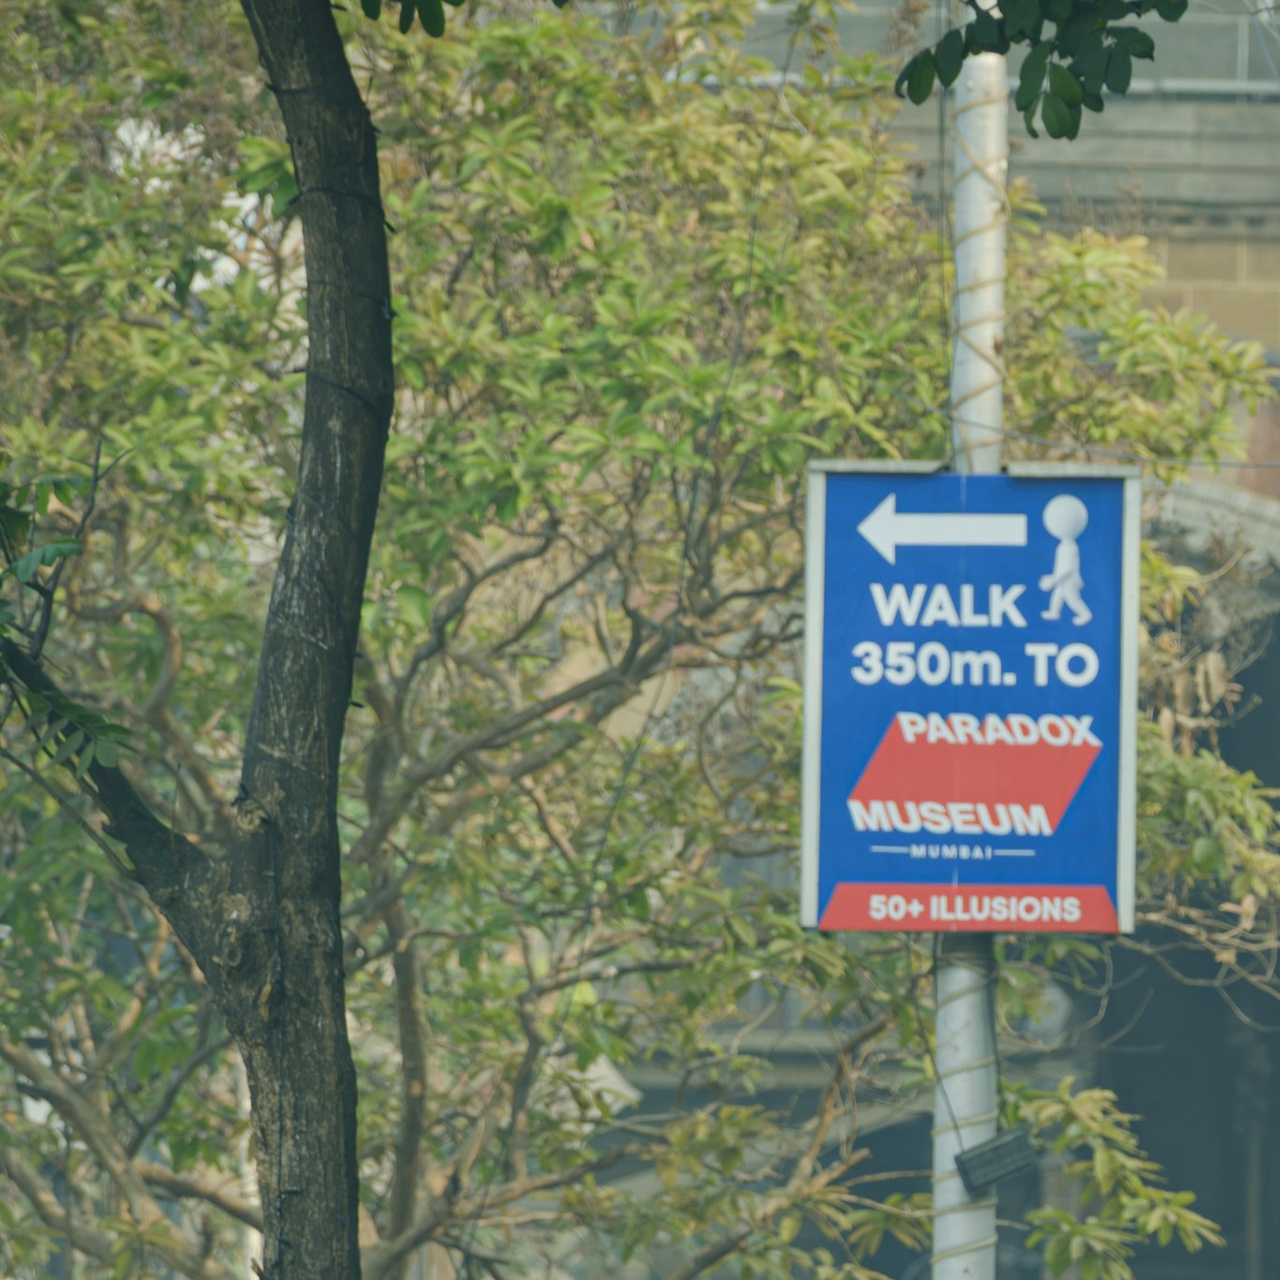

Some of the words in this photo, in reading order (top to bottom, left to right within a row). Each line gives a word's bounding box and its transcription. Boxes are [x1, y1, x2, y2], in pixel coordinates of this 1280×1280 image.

[870, 584, 1027, 627] WALK
[851, 641, 1016, 686] 350m.
[1025, 642, 1099, 687] TO
[897, 712, 1102, 747] PARADOX
[847, 799, 1053, 835] MUSEUM
[910, 844, 993, 860] MUMBAI
[868, 894, 925, 920] 50+
[930, 895, 1081, 922] ILLUSIONS
